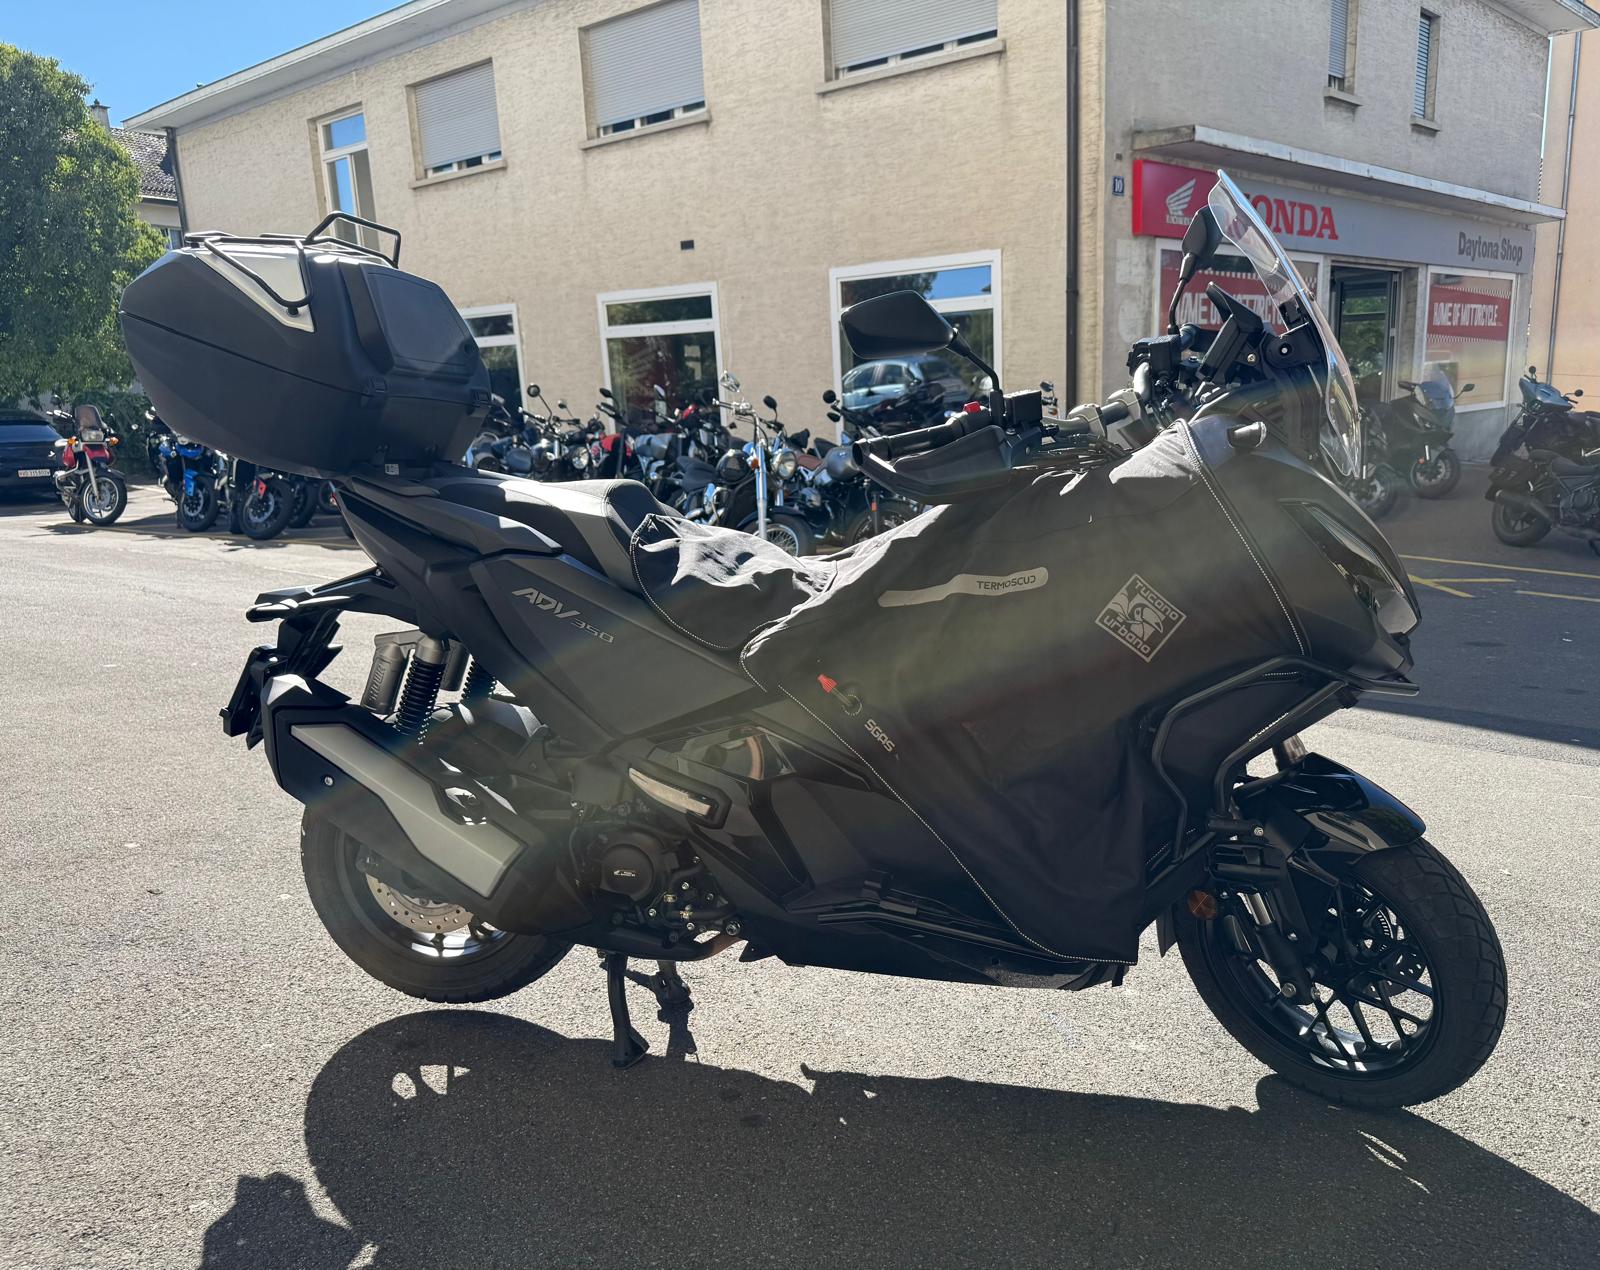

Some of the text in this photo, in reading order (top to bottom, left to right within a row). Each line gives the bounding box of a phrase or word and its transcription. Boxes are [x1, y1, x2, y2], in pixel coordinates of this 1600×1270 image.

[1114, 178, 1124, 194] 10
[1244, 193, 1339, 240] ONDA
[1458, 231, 1523, 266] Daytona Shop
[511, 587, 614, 643] ADV 350
[864, 718, 896, 753] SGAS
